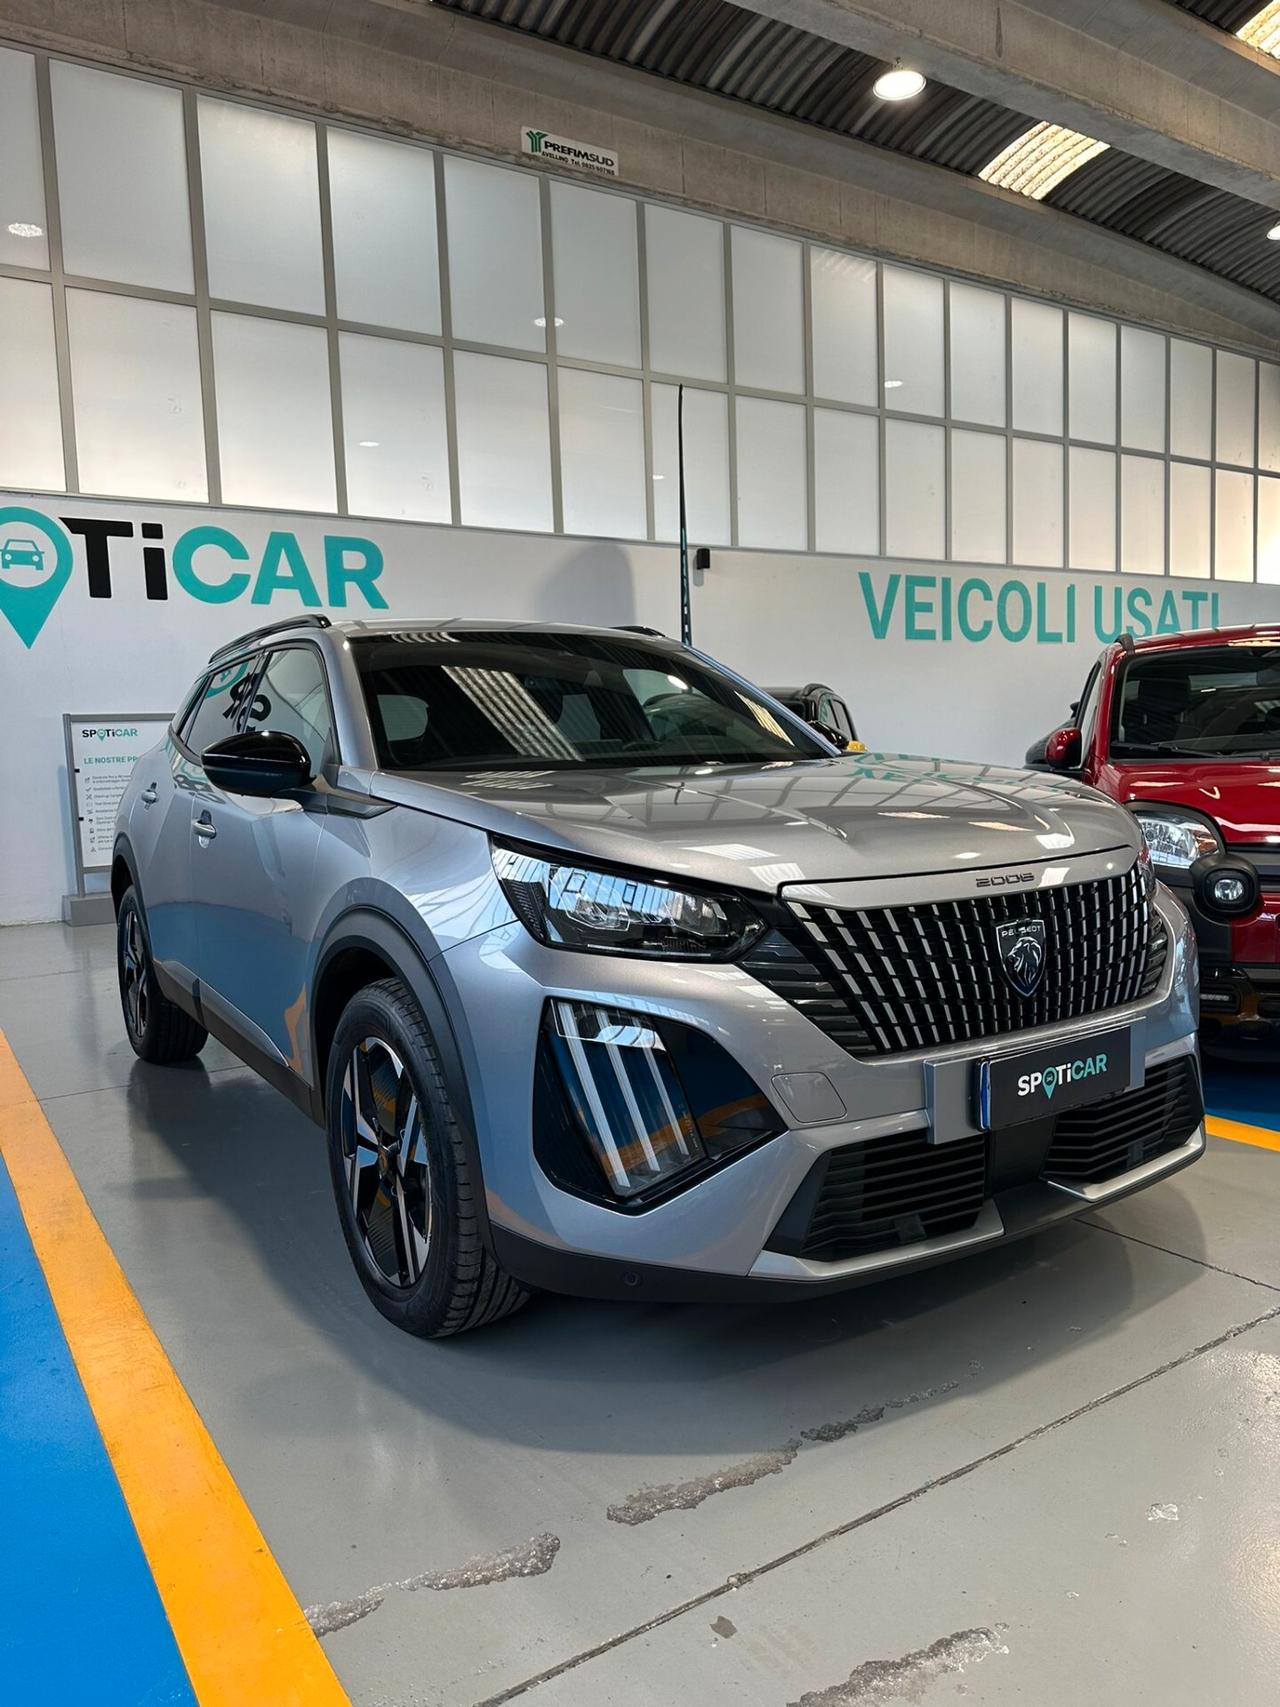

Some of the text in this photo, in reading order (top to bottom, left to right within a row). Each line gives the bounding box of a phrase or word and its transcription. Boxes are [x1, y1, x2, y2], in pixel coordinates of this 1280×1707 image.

[544, 141, 614, 167] PREFIMSUD
[858, 571, 1219, 644] VEICOLI USATI
[95, 756, 127, 764] NOSTRE
